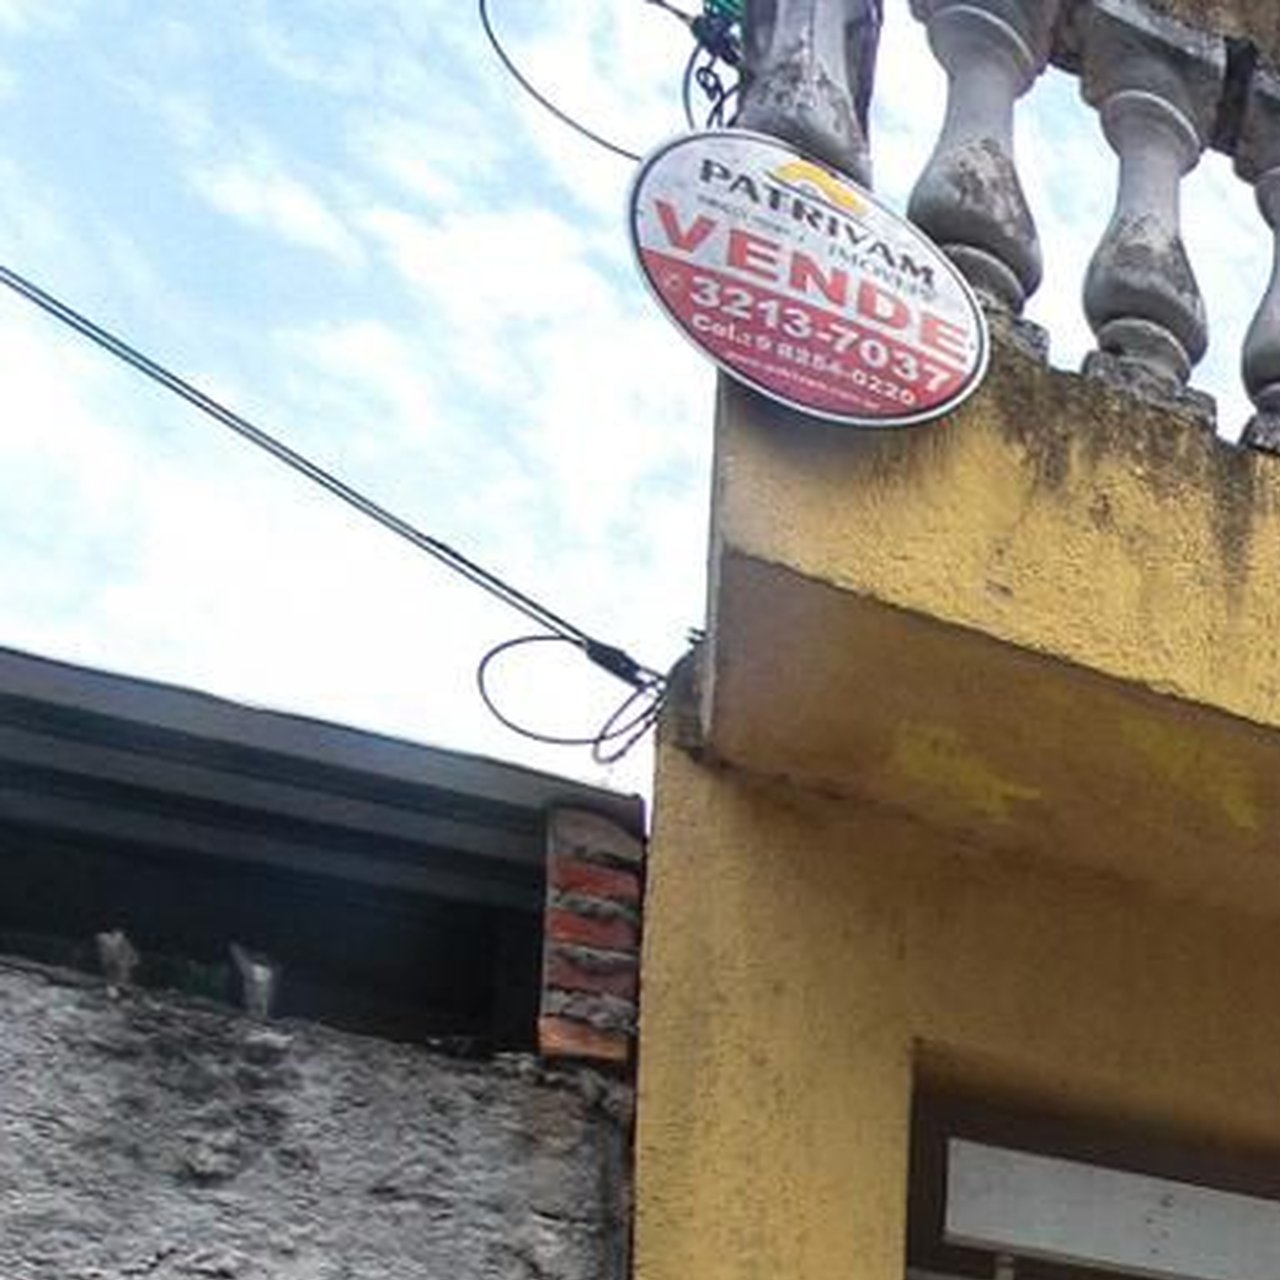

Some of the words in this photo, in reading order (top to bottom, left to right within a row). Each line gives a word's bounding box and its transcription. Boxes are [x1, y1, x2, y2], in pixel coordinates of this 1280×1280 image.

[653, 198, 968, 363] VENDE
[699, 158, 935, 290] PATRIVAM
[692, 275, 953, 394] 3213-7037
